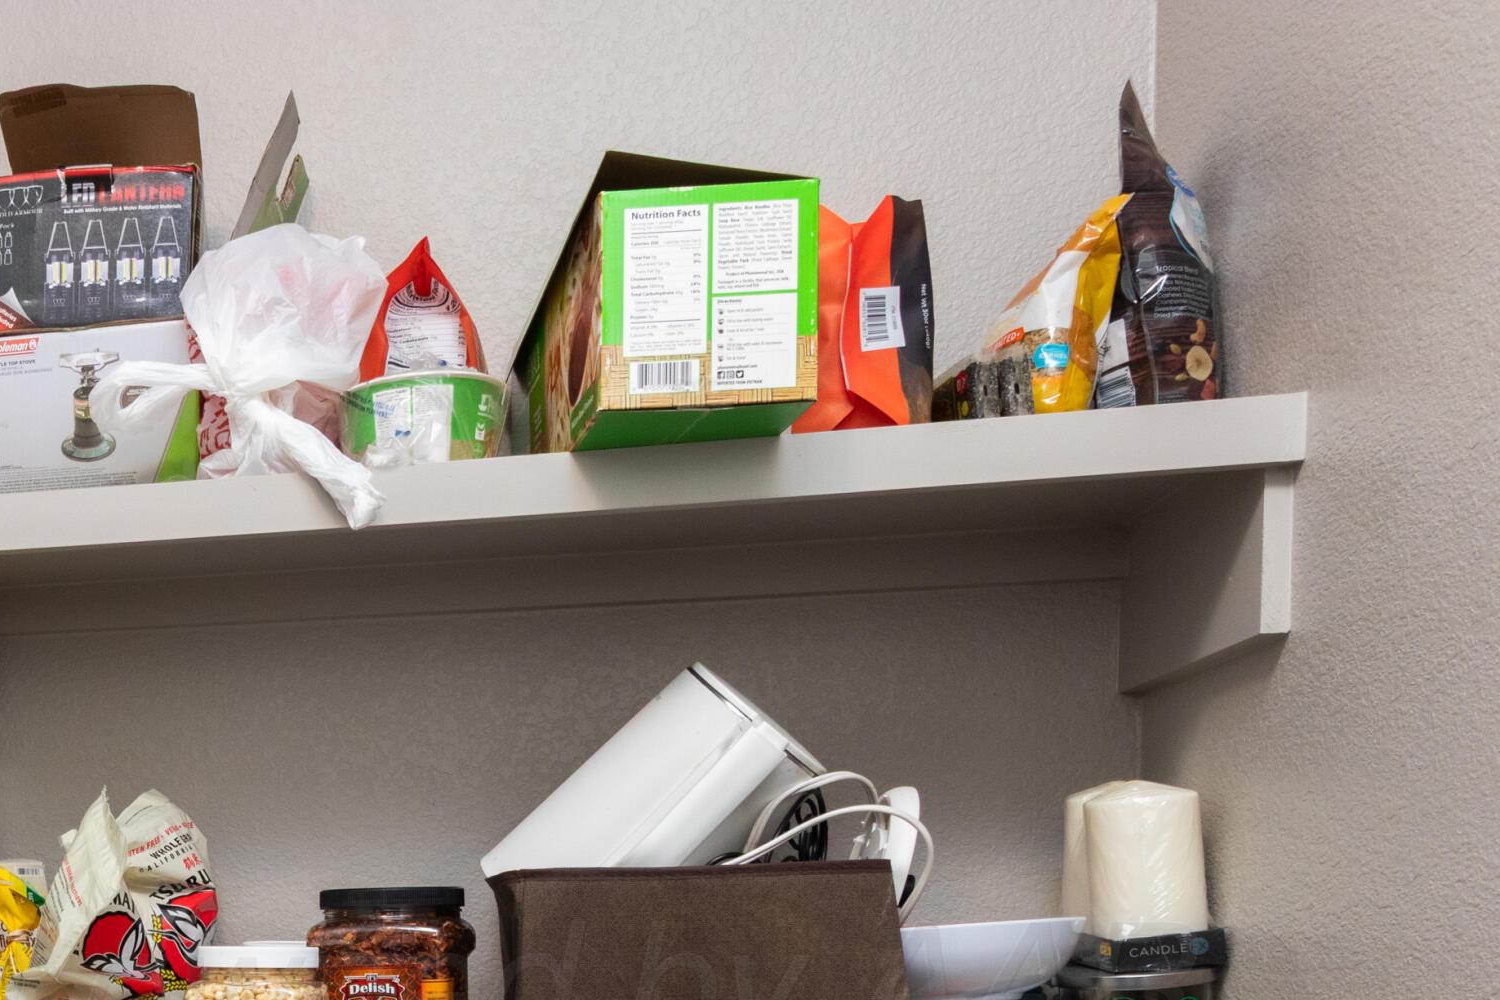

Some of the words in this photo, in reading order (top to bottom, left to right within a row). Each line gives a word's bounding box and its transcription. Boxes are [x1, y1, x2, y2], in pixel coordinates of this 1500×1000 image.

[631, 210, 674, 220] Nutrition
[677, 209, 701, 218] Facts
[150, 837, 182, 859] WHOLE
[1129, 943, 1189, 958] CANDLE
[348, 983, 396, 995] Delish
